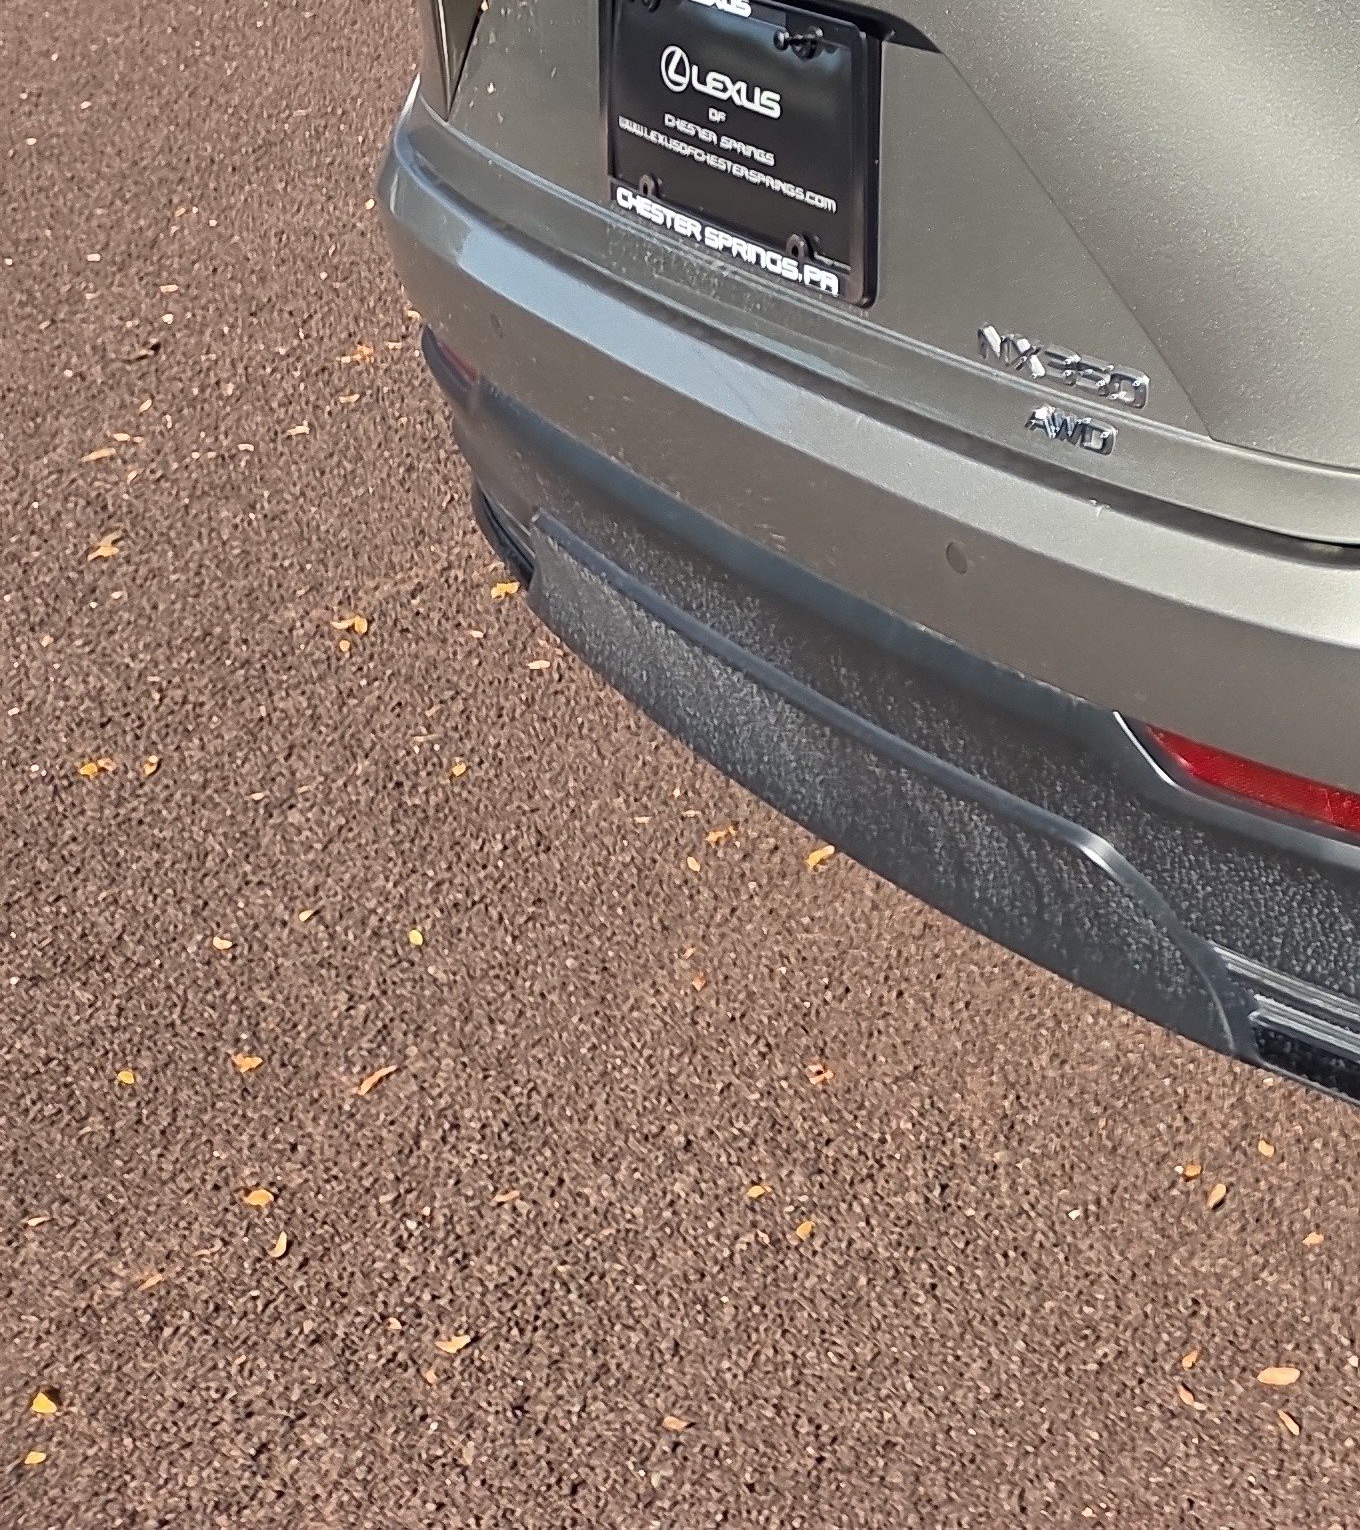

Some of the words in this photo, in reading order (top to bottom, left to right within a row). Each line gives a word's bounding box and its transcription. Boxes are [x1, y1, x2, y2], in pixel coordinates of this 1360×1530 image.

[692, 64, 781, 119] LEXUS
[709, 107, 727, 123] OF
[664, 112, 717, 145] CHESTER
[719, 135, 775, 167] SPRINGS
[616, 186, 702, 241] CHESTER
[803, 264, 840, 297] PA
[1025, 404, 1118, 455] AWD
